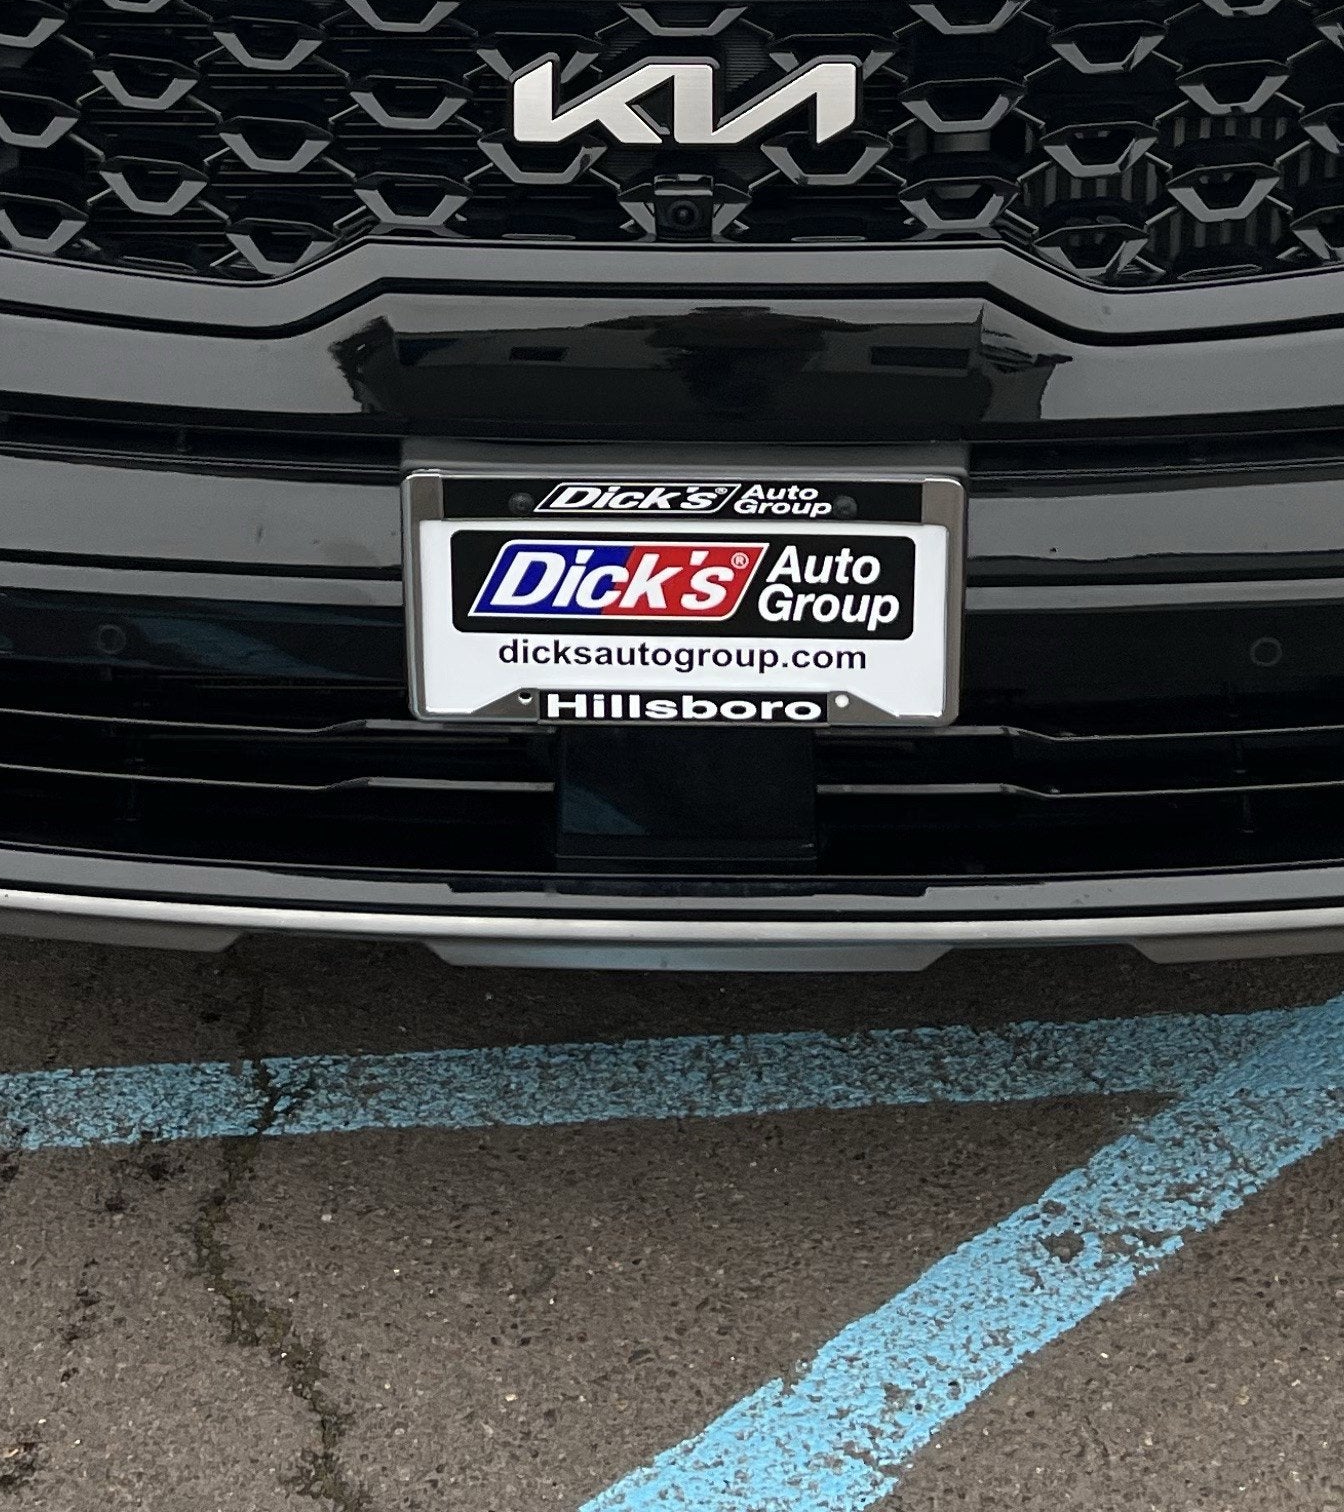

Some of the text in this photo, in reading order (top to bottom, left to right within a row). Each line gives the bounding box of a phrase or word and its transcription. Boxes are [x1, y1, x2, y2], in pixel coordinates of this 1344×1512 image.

[549, 485, 719, 510] Dick's
[733, 498, 833, 518] Group
[740, 484, 820, 501] Auto
[489, 549, 734, 610] Dick's
[766, 544, 881, 585] Auto
[757, 583, 900, 632] Group
[498, 638, 867, 674] dicksautogroup.com
[546, 692, 823, 721] Hillsboro
